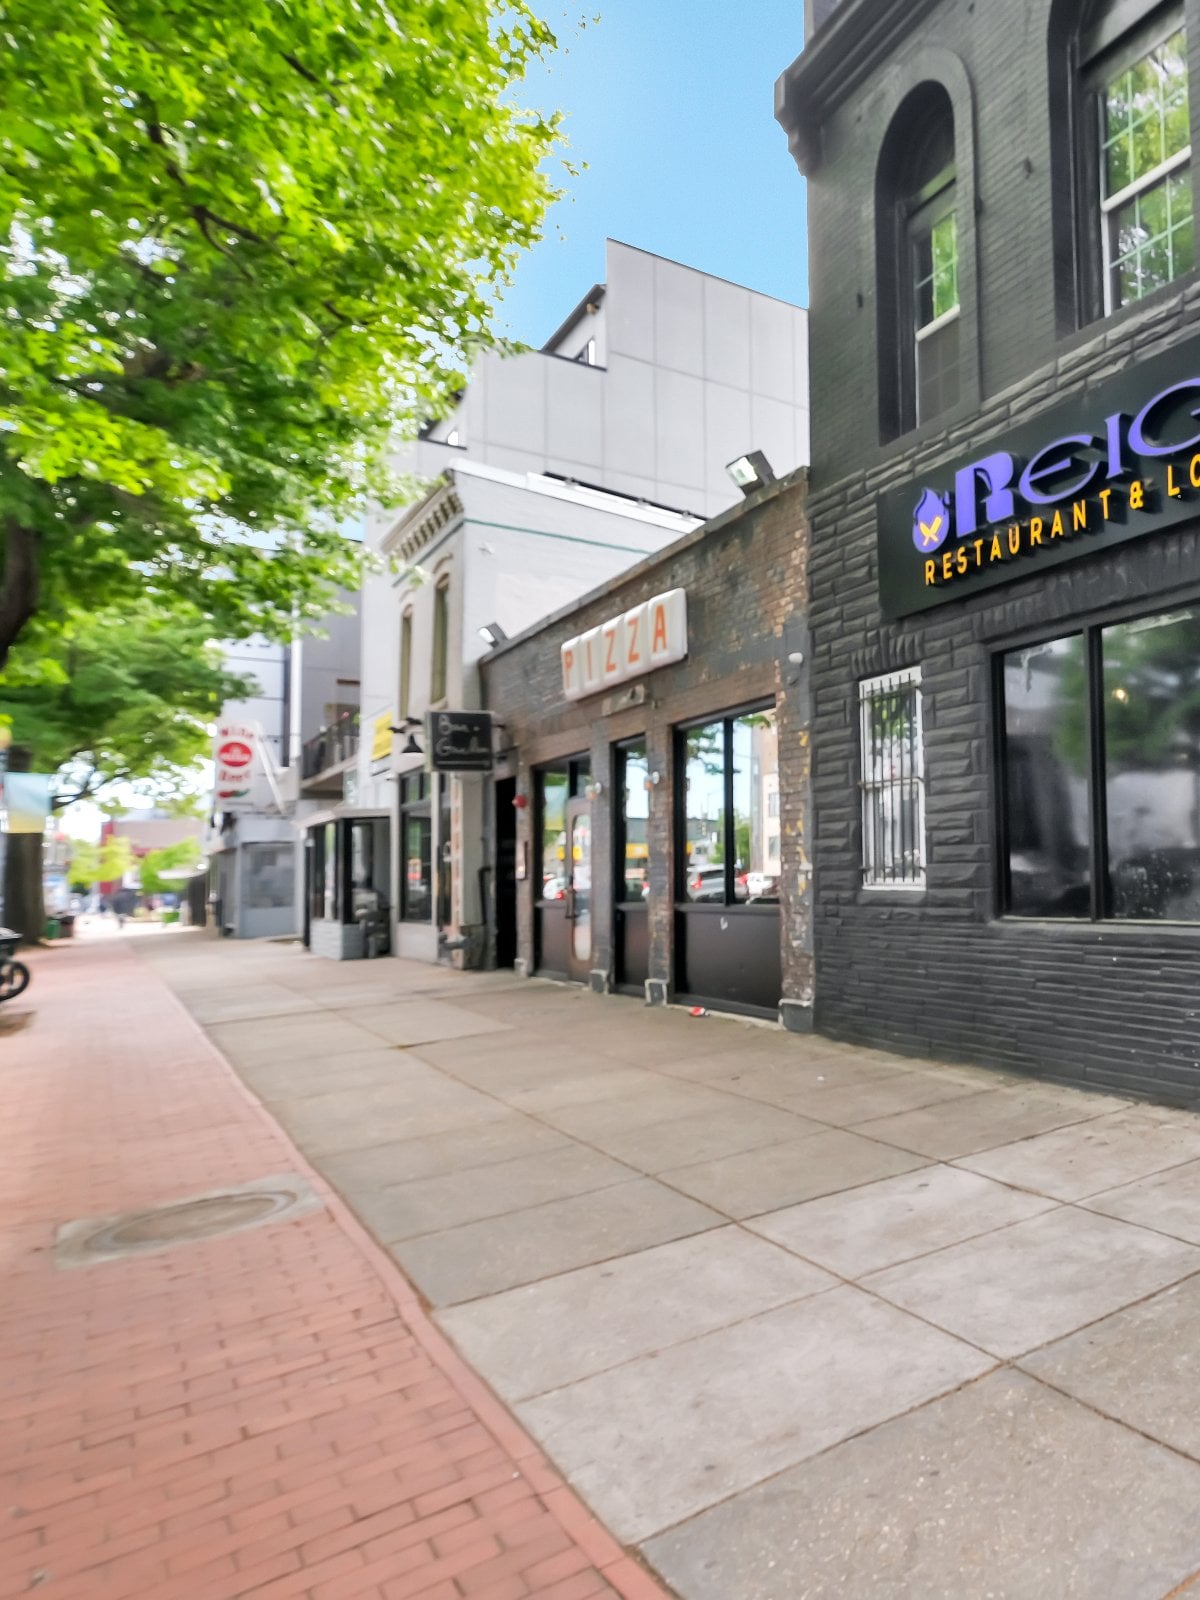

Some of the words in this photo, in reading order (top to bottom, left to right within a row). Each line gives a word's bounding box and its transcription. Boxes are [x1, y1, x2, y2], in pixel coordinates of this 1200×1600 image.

[924, 486, 1111, 586] RESTAURANT
[1129, 479, 1145, 510] &
[563, 603, 668, 690] PIZZA
